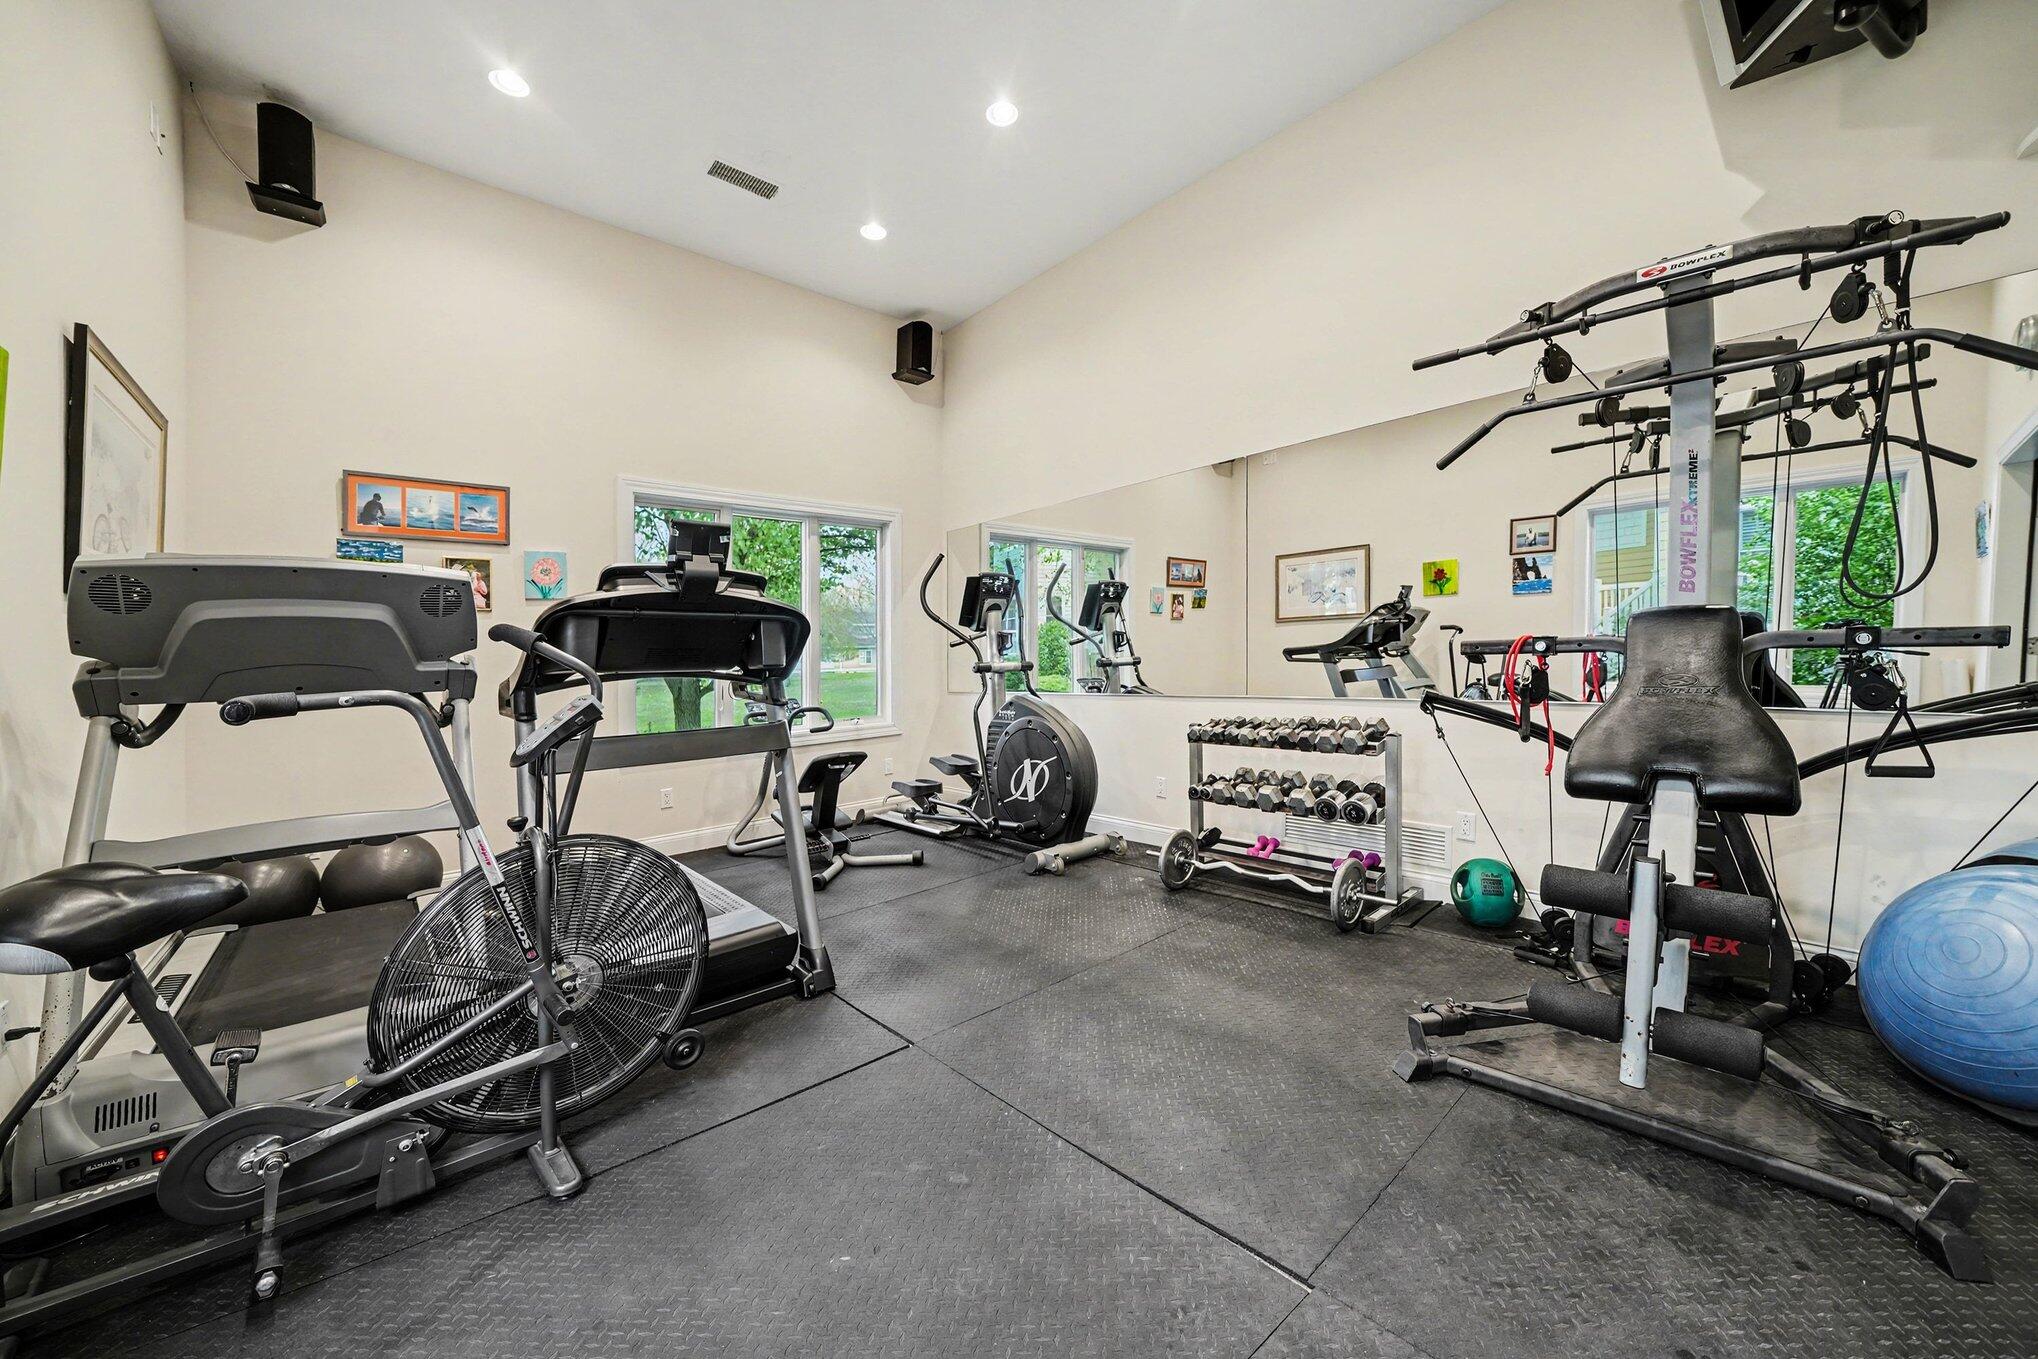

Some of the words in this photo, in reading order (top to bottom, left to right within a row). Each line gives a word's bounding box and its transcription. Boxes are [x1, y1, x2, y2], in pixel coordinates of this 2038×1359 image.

[1670, 250, 1726, 270] BOWFLEX
[1678, 500, 1698, 593] BOWFLEX
[496, 886, 533, 949] SCHWINN
